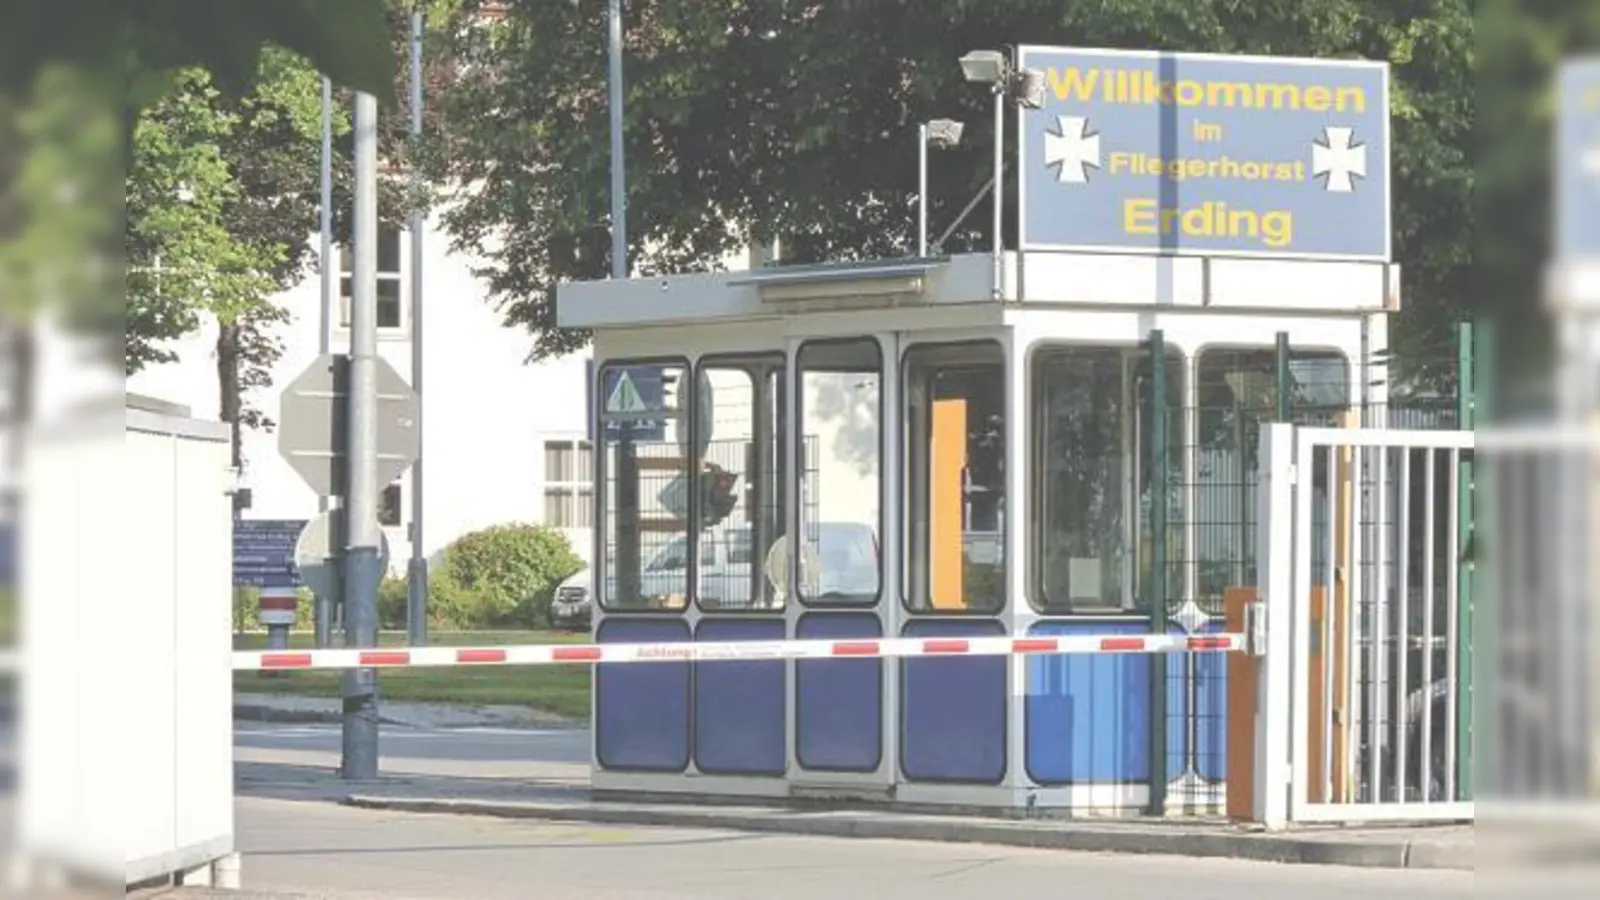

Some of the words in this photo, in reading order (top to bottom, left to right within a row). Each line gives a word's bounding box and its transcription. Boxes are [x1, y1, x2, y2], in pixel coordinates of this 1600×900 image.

[1046, 66, 1366, 113] Willkommen
[1108, 151, 1306, 182] Fliegerhorst
[1123, 197, 1293, 248] Erding
